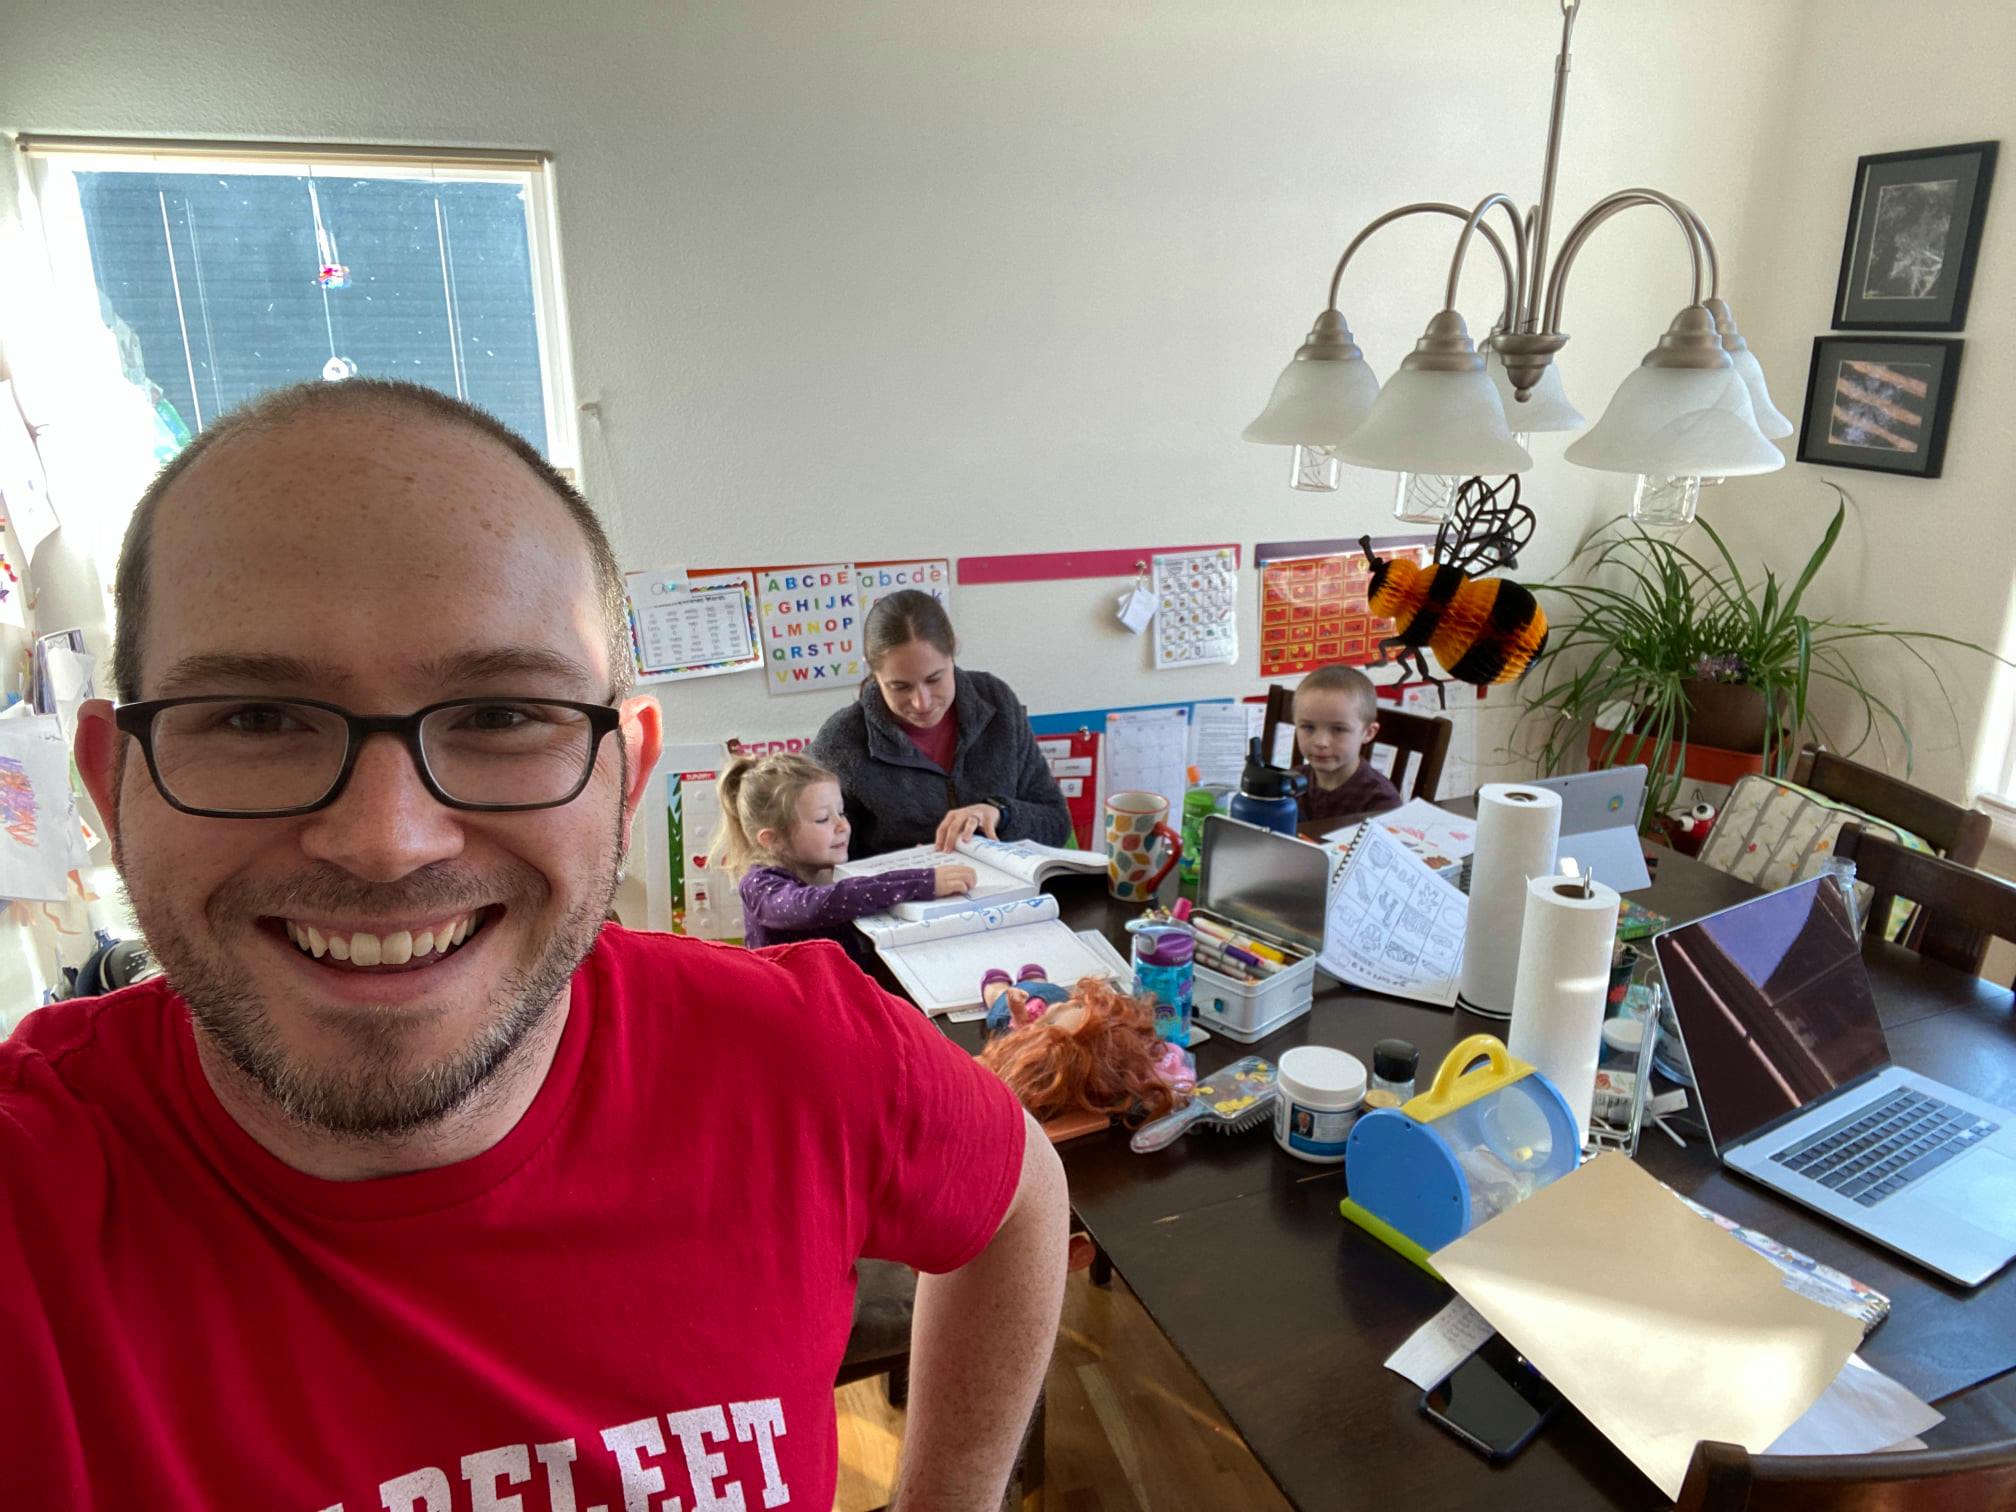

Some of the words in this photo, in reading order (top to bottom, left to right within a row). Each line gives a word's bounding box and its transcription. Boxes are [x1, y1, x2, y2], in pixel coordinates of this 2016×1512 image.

[768, 579, 780, 592] A
[786, 577, 797, 590] B
[803, 575, 814, 588] C
[820, 574, 831, 586] D
[837, 572, 848, 584] E
[862, 575, 873, 587] a
[880, 571, 891, 586] b
[896, 573, 907, 584] c
[912, 567, 924, 583] d
[930, 569, 941, 581] e
[779, 602, 791, 614] G
[796, 600, 808, 612] H
[814, 598, 820, 610] I
[826, 597, 835, 609] J
[841, 594, 853, 607] K
[772, 626, 782, 638] L
[788, 624, 802, 636] M
[807, 623, 820, 634] N
[825, 619, 837, 632] O
[843, 618, 853, 629] P
[773, 648, 785, 661] Q
[791, 647, 803, 659] R
[808, 644, 818, 656] S
[824, 642, 835, 654] T
[841, 640, 852, 653] U
[776, 671, 788, 683] V
[793, 668, 809, 681] W
[814, 666, 825, 678] X
[830, 664, 841, 676] Y
[848, 661, 858, 674] Z
